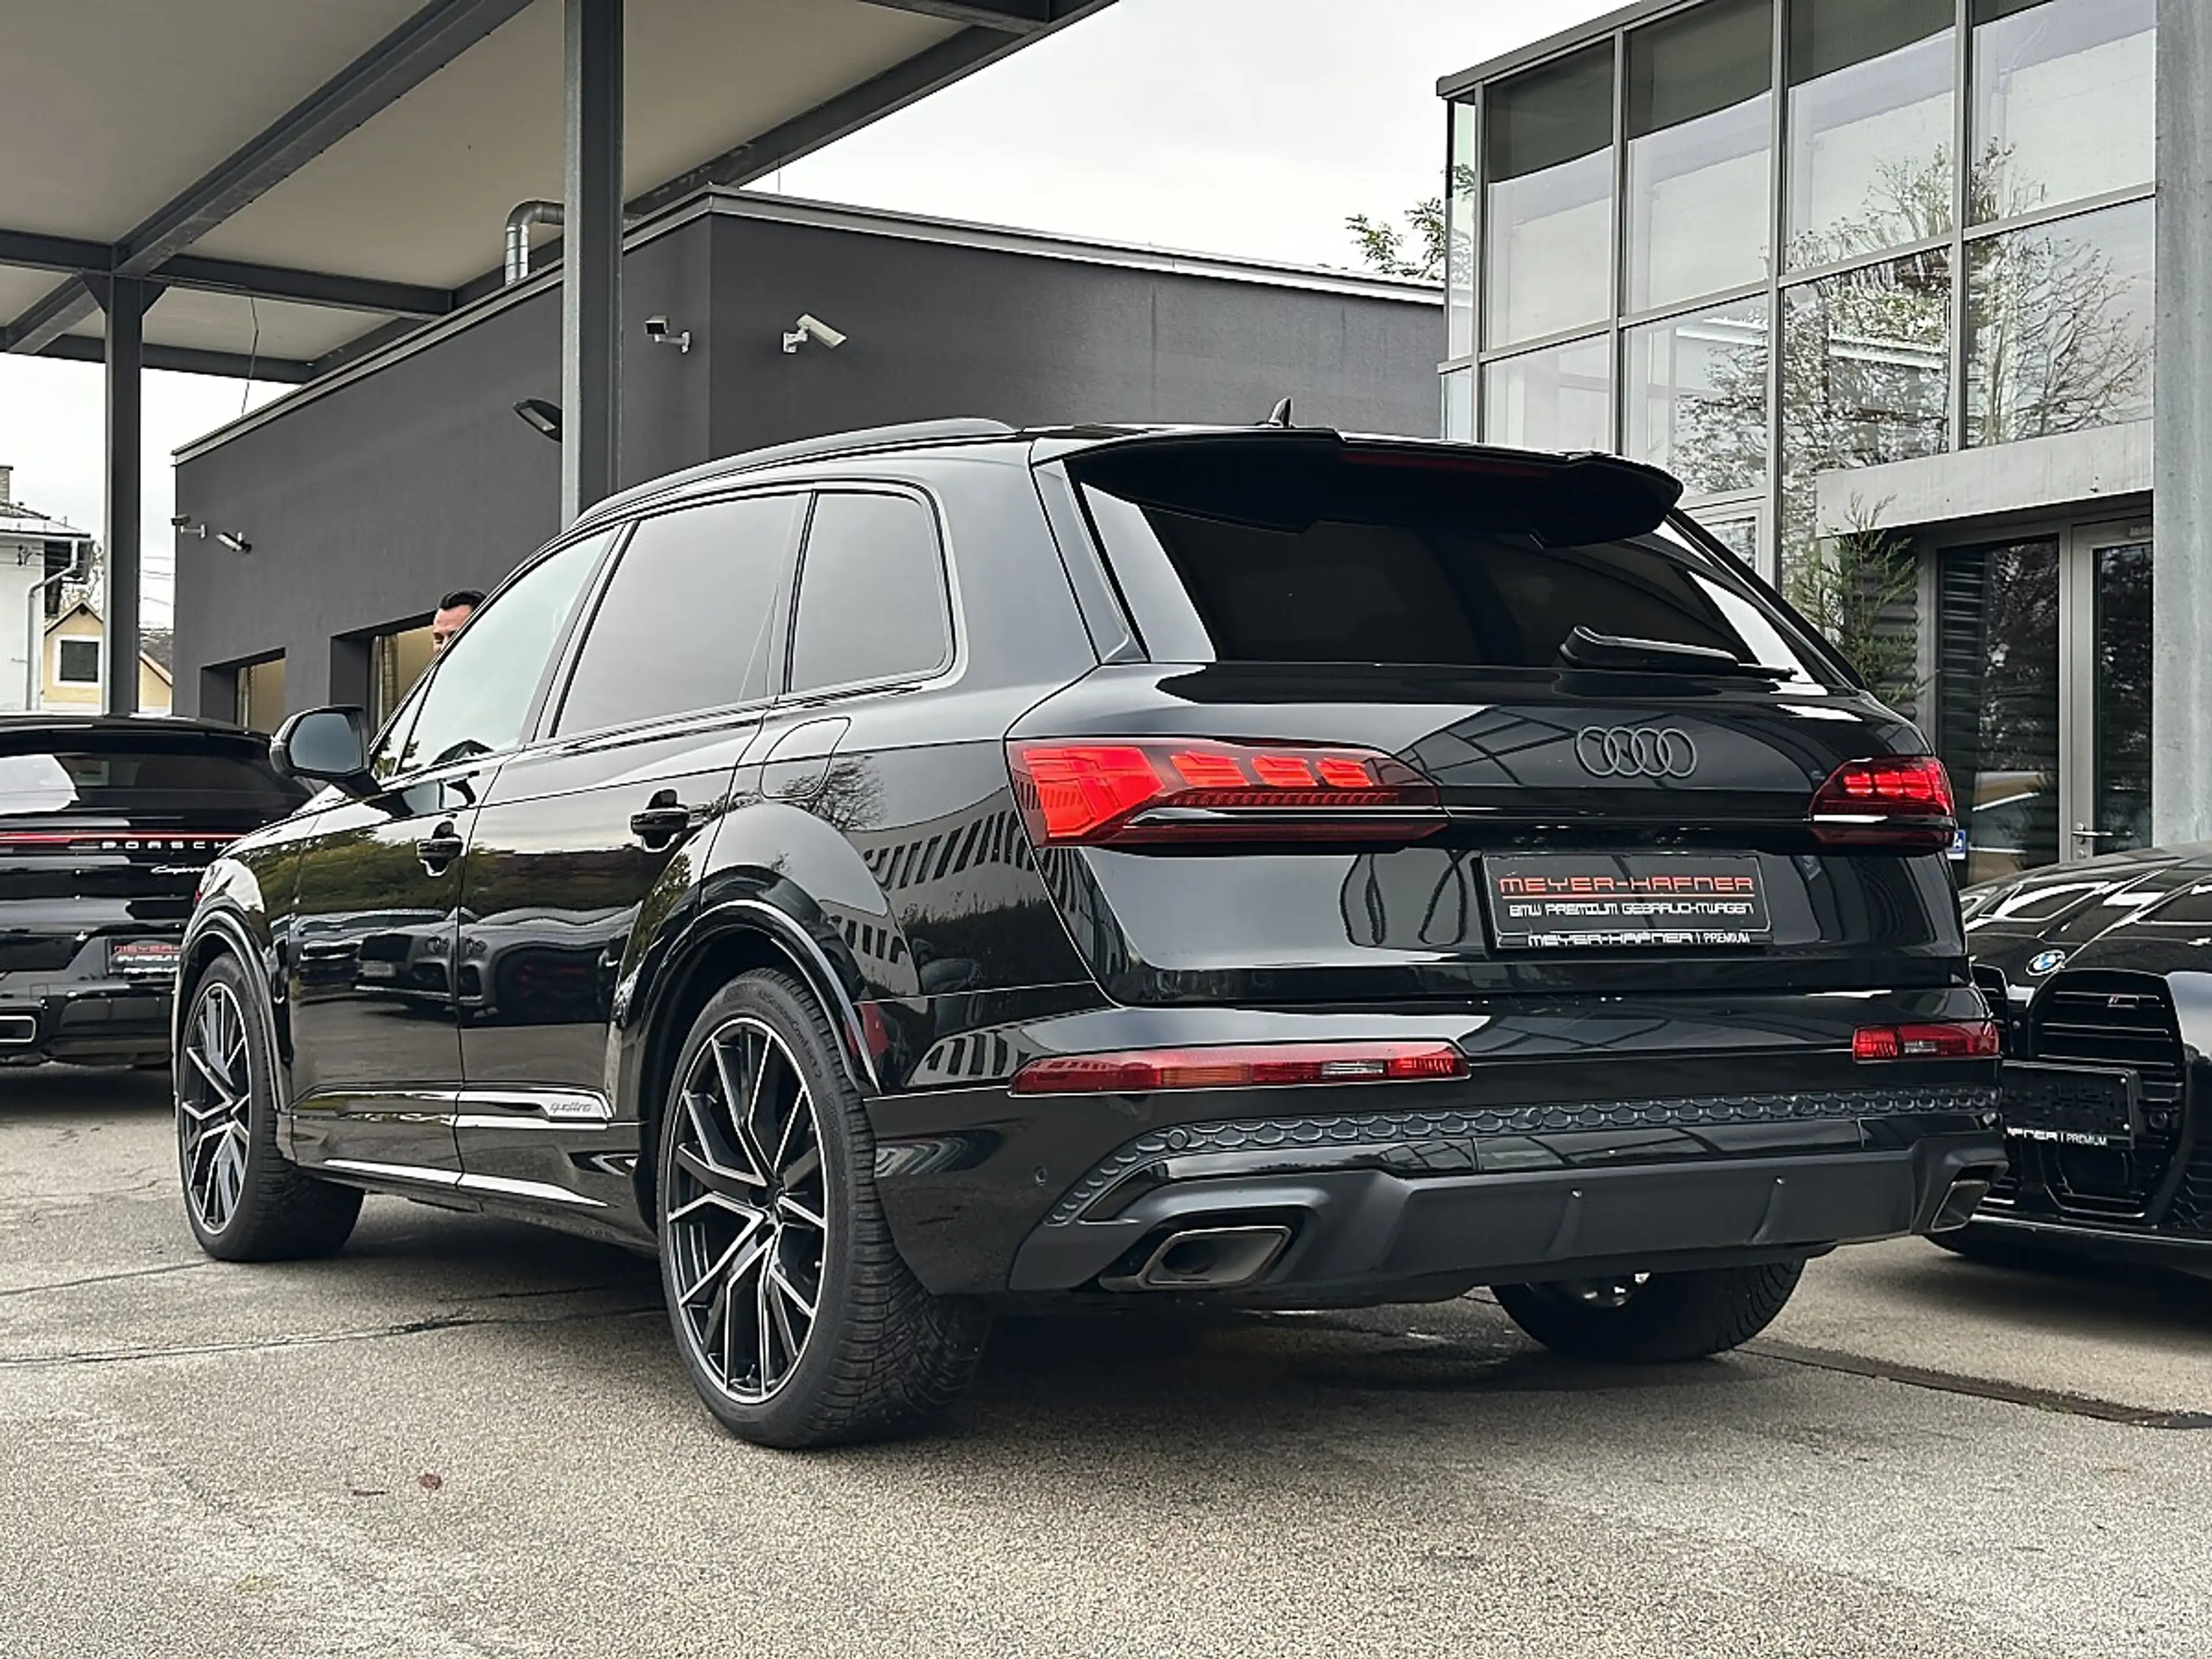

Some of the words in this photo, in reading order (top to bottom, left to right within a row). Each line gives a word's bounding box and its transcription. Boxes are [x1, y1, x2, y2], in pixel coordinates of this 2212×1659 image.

[102, 841, 227, 849] PORSCH
[1499, 877, 1753, 893] MEYER-HAFNER
[1509, 904, 1541, 917] BMW
[1545, 903, 1618, 916] PREMIUM
[1622, 902, 1754, 915] GEBRAUCHTWAGEN
[1528, 932, 1693, 946] MEYER-HAFNER
[1703, 933, 1750, 943] PREMIUM
[550, 1103, 592, 1113] quattro
[2066, 1134, 2107, 1146] PREMIUM
